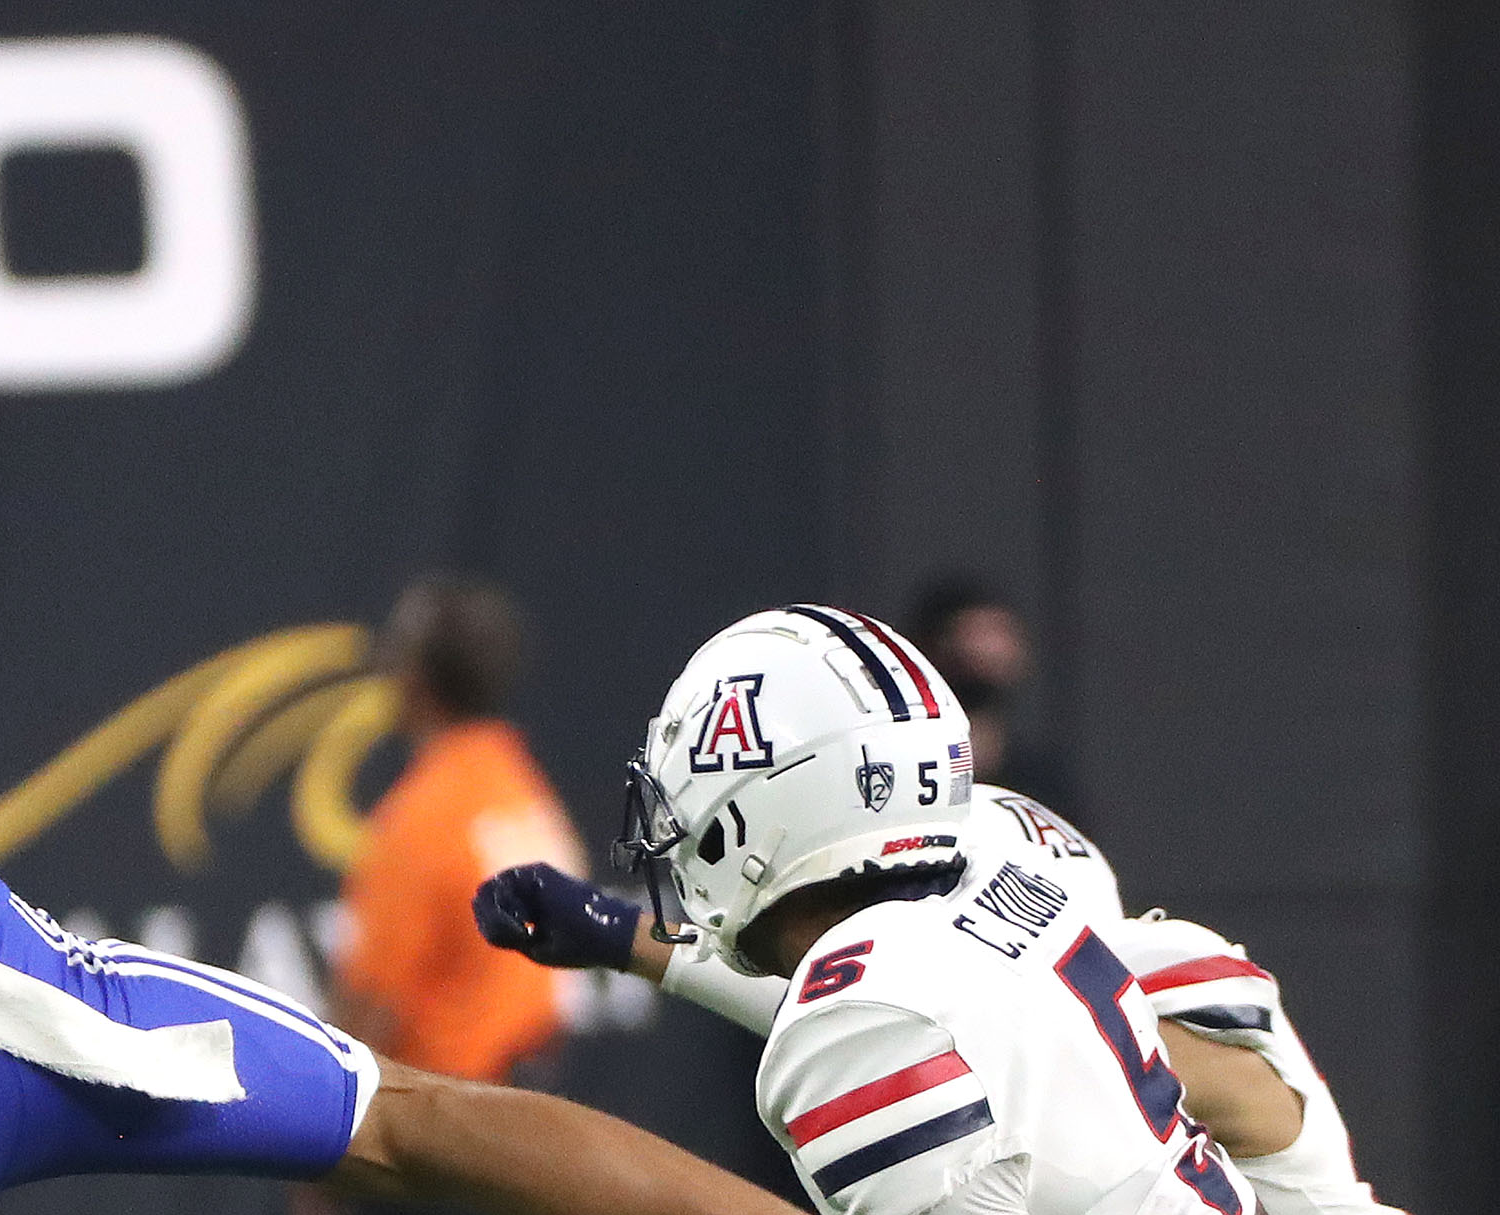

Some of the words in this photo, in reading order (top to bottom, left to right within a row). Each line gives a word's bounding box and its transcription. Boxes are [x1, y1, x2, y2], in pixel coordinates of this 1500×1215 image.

[689, 673, 773, 773] A
[917, 760, 938, 806] 5
[973, 860, 1068, 939] YOUNG
[953, 913, 1028, 960] C.
[796, 939, 874, 1004] 5
